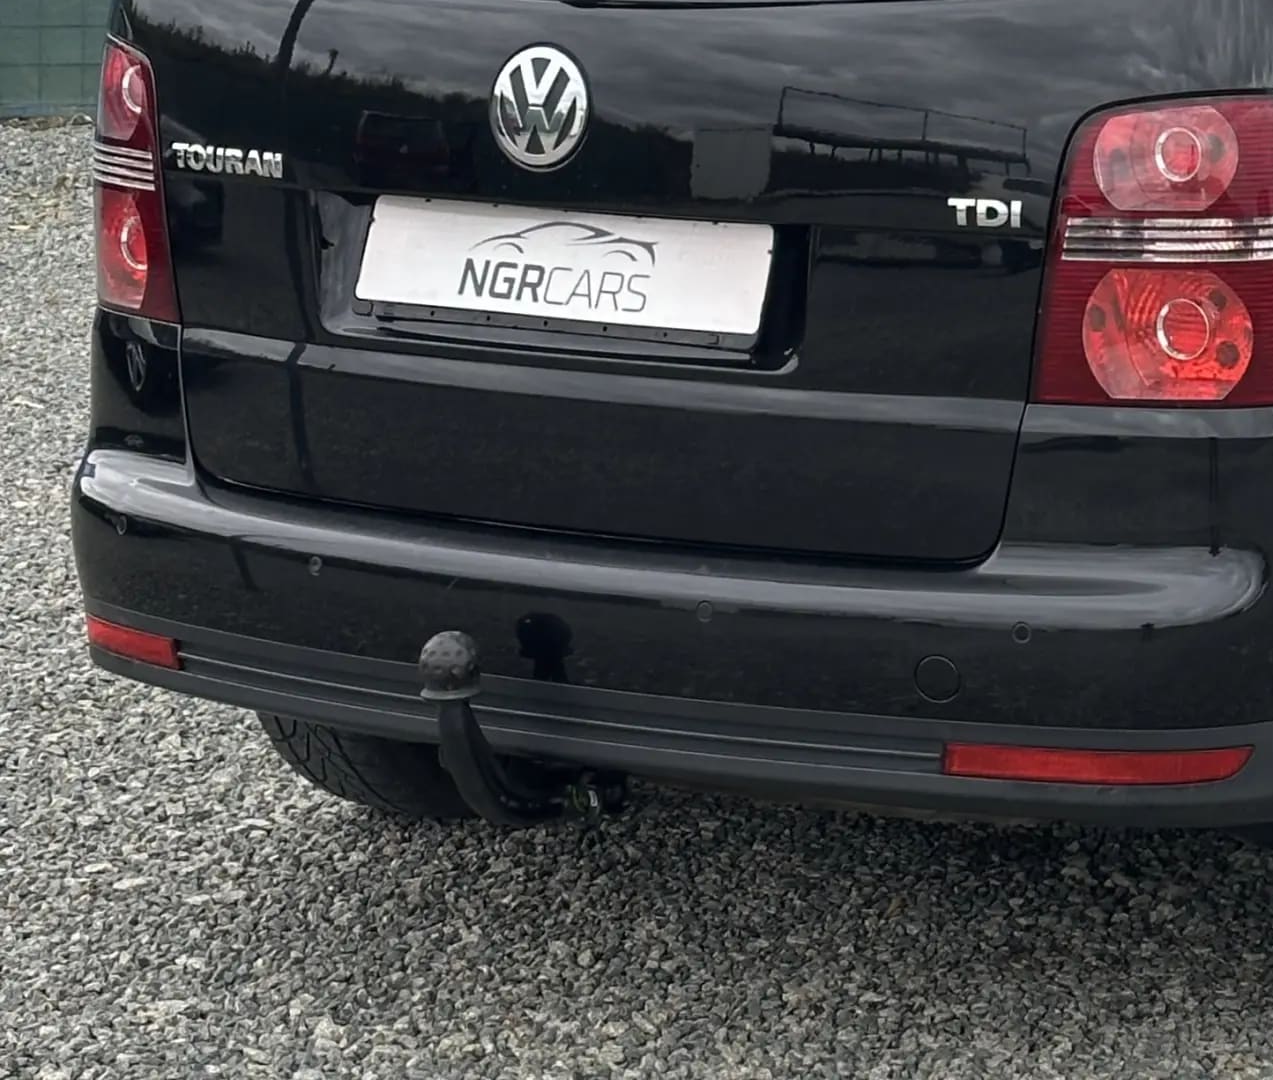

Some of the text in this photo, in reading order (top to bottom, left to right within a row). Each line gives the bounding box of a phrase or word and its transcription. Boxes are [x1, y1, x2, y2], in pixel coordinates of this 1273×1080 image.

[172, 141, 284, 180] TOURAN
[946, 197, 1023, 229] TDI
[457, 257, 651, 313] NGRCARS
